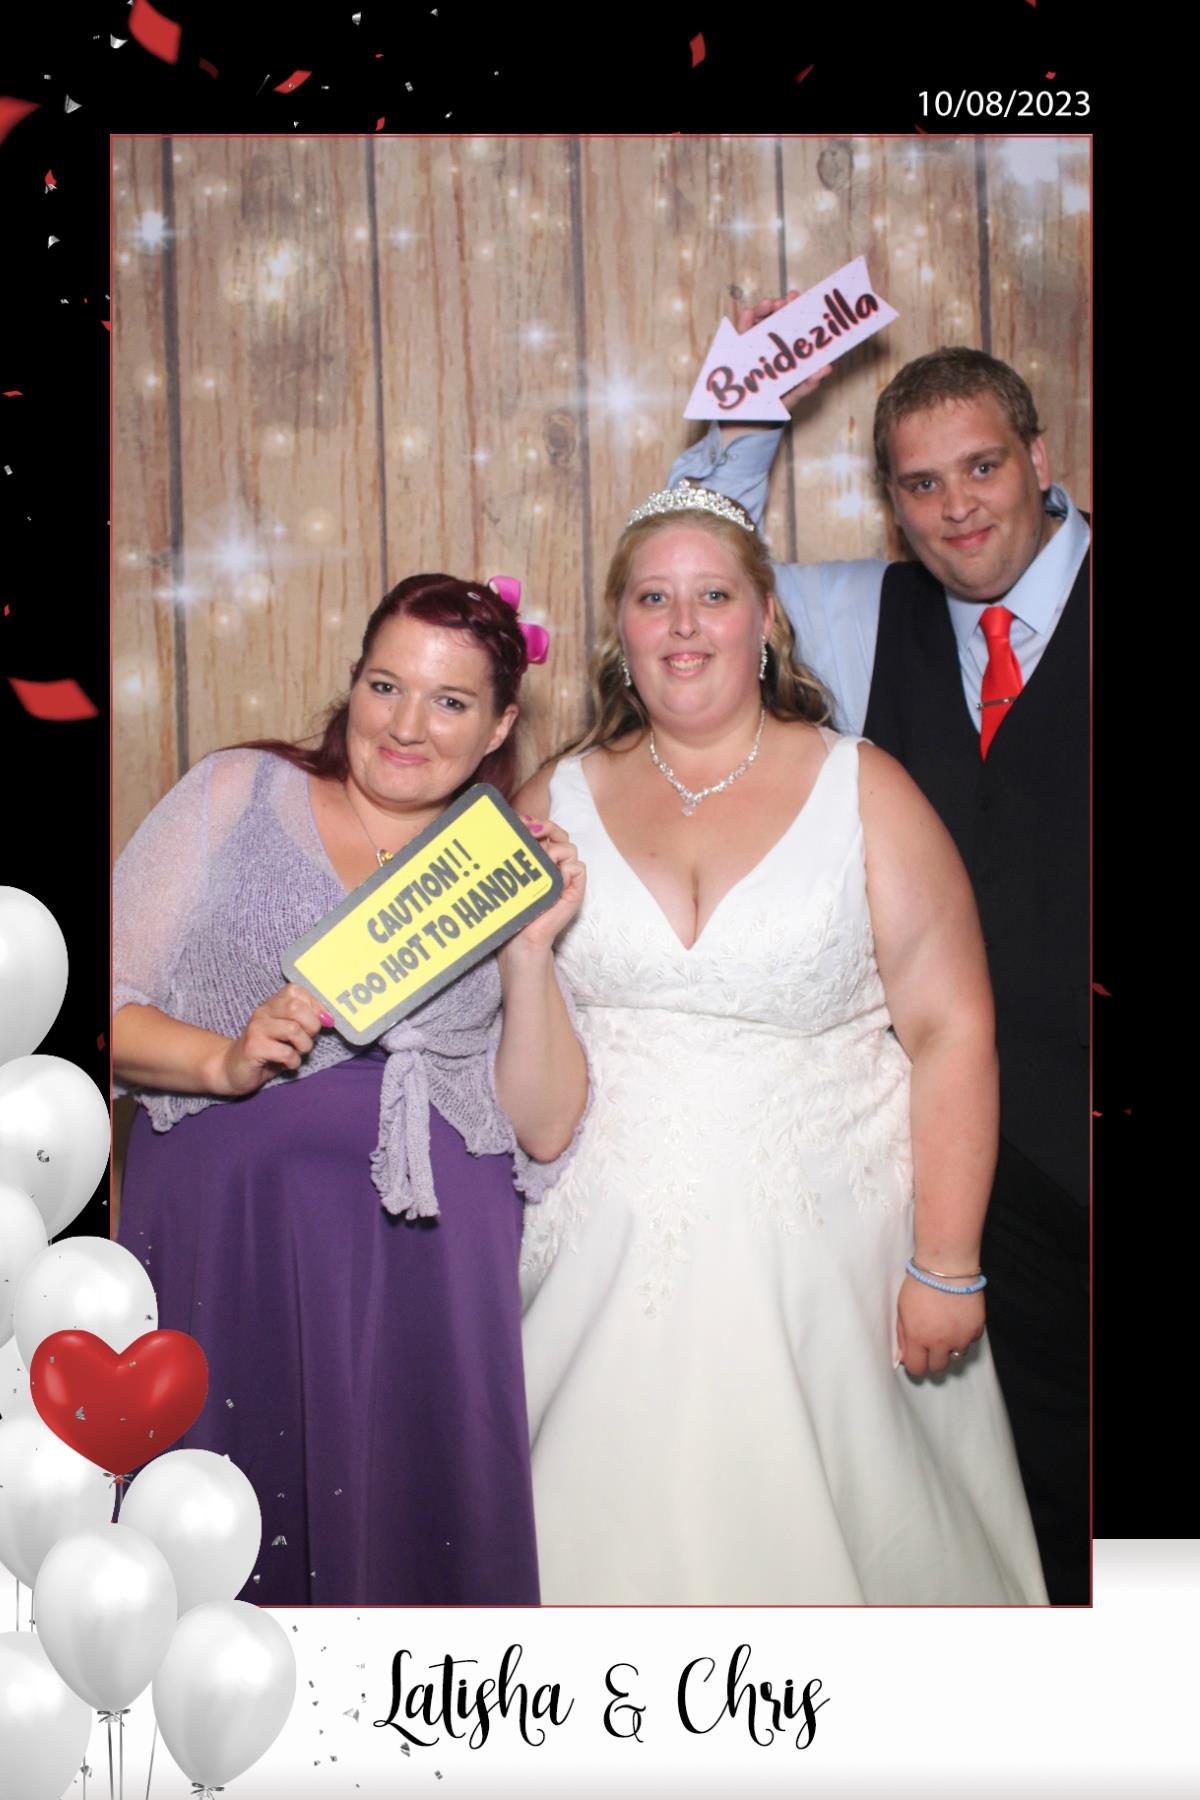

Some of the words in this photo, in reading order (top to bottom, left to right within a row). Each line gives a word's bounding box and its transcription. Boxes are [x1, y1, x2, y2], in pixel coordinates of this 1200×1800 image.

[706, 288, 879, 411] Bridezilla
[336, 972, 387, 1015] TOO
[380, 934, 431, 983] HOT
[421, 915, 461, 949] TO
[451, 848, 543, 930] HANDLE
[366, 838, 480, 944] CAUTION!!
